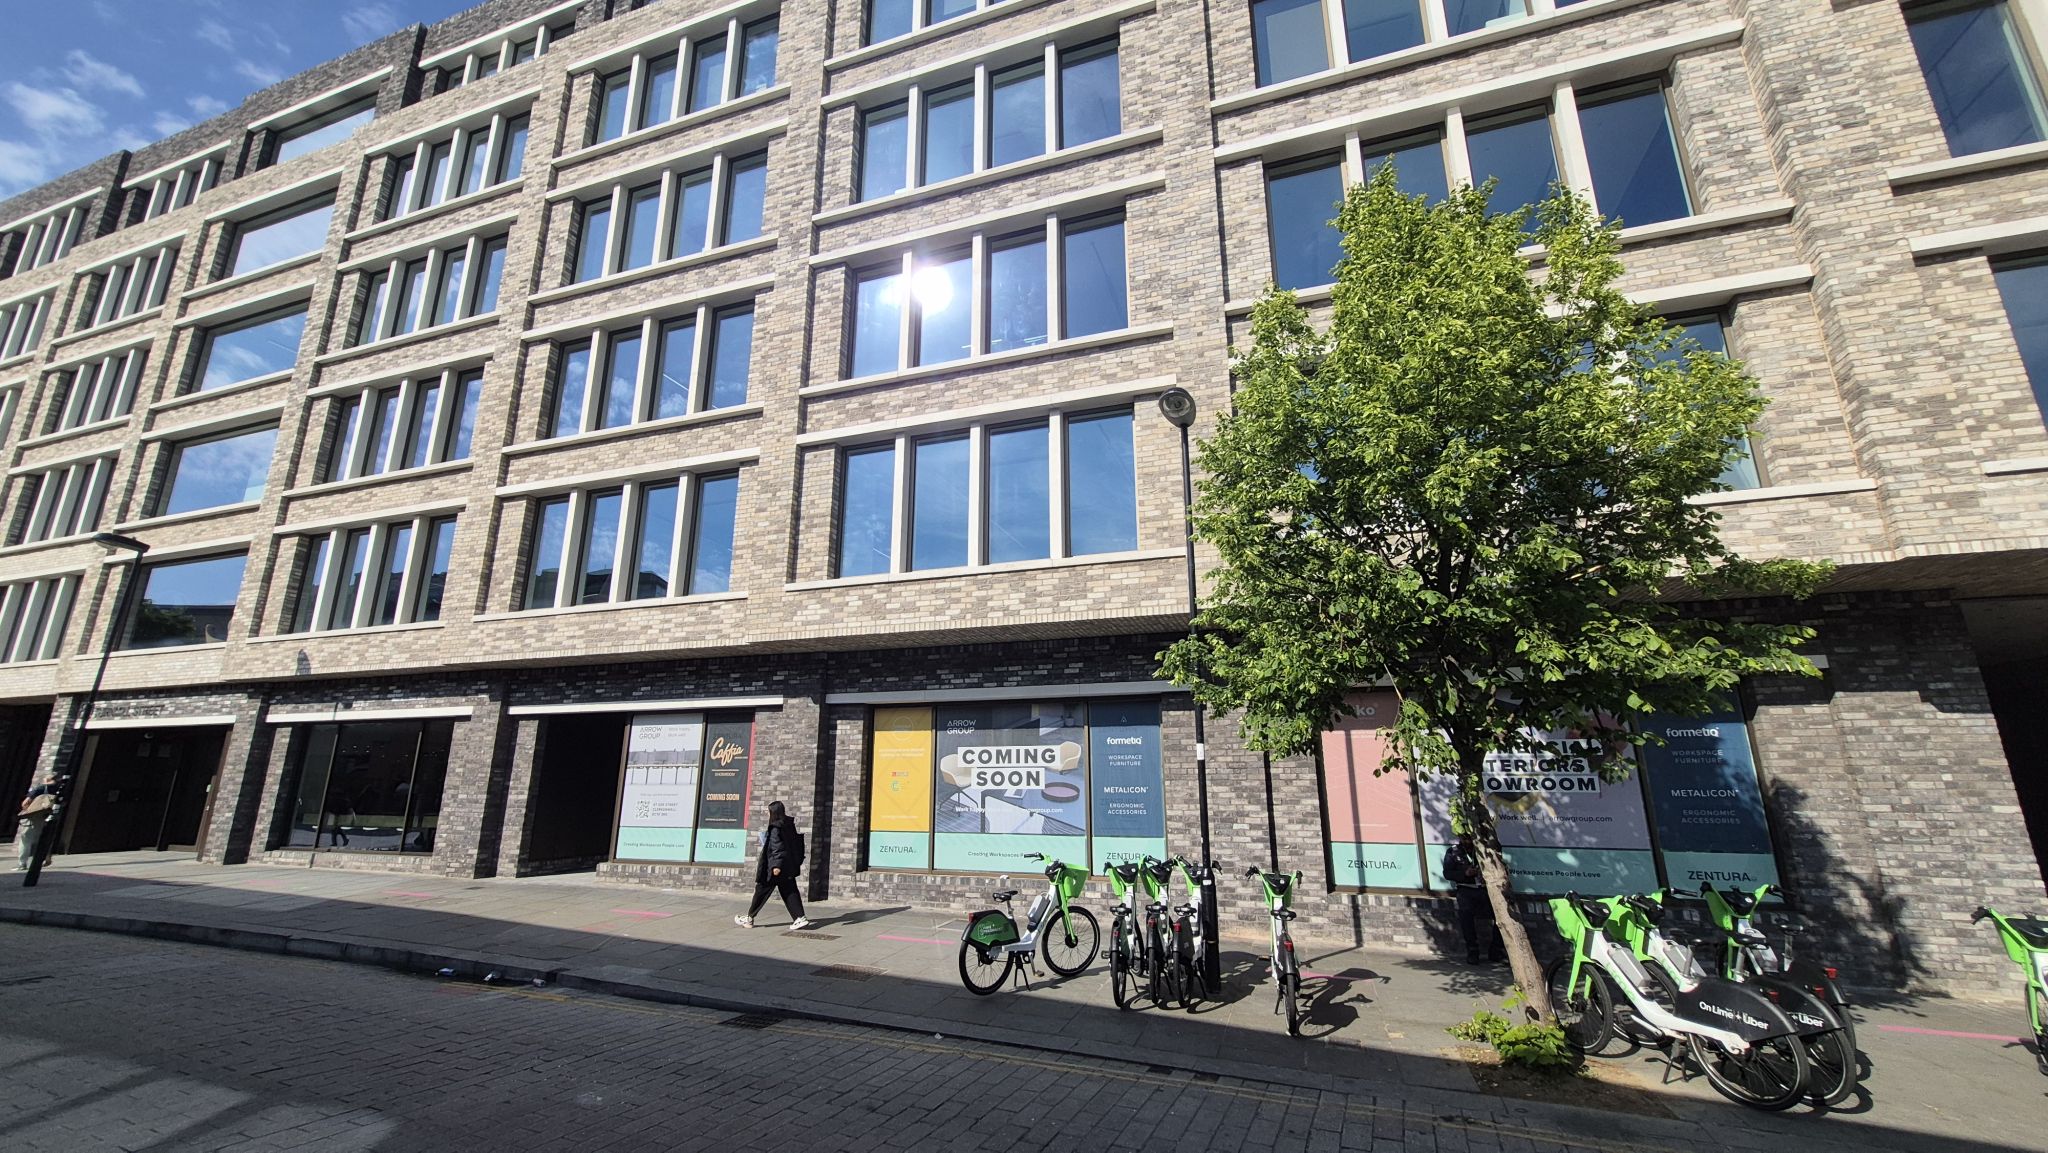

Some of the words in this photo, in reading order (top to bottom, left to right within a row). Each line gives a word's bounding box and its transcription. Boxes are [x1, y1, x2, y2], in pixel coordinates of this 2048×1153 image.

[947, 719, 977, 727] ARROW
[946, 727, 975, 735] GROUP
[962, 748, 1056, 765] COMING
[976, 770, 1041, 787] SOON
[1486, 777, 1597, 791] OWROOM
[1103, 786, 1147, 794] METALICON
[1671, 789, 1736, 797] METALICON
[706, 793, 725, 801] COMING
[725, 793, 740, 801] SOON
[1681, 817, 1741, 825] ACCESSORIES
[879, 845, 914, 854] ZENTURA
[1347, 859, 1397, 870] ZENTURA
[1509, 868, 1554, 877] Workspaces
[1555, 870, 1581, 878] People
[1687, 870, 1752, 882] ZENTURA
[1699, 1001, 1712, 1012] On
[1712, 1004, 1734, 1019] Lime
[1742, 1015, 1769, 1030] Uber
[1798, 1013, 1824, 1028] Uber
